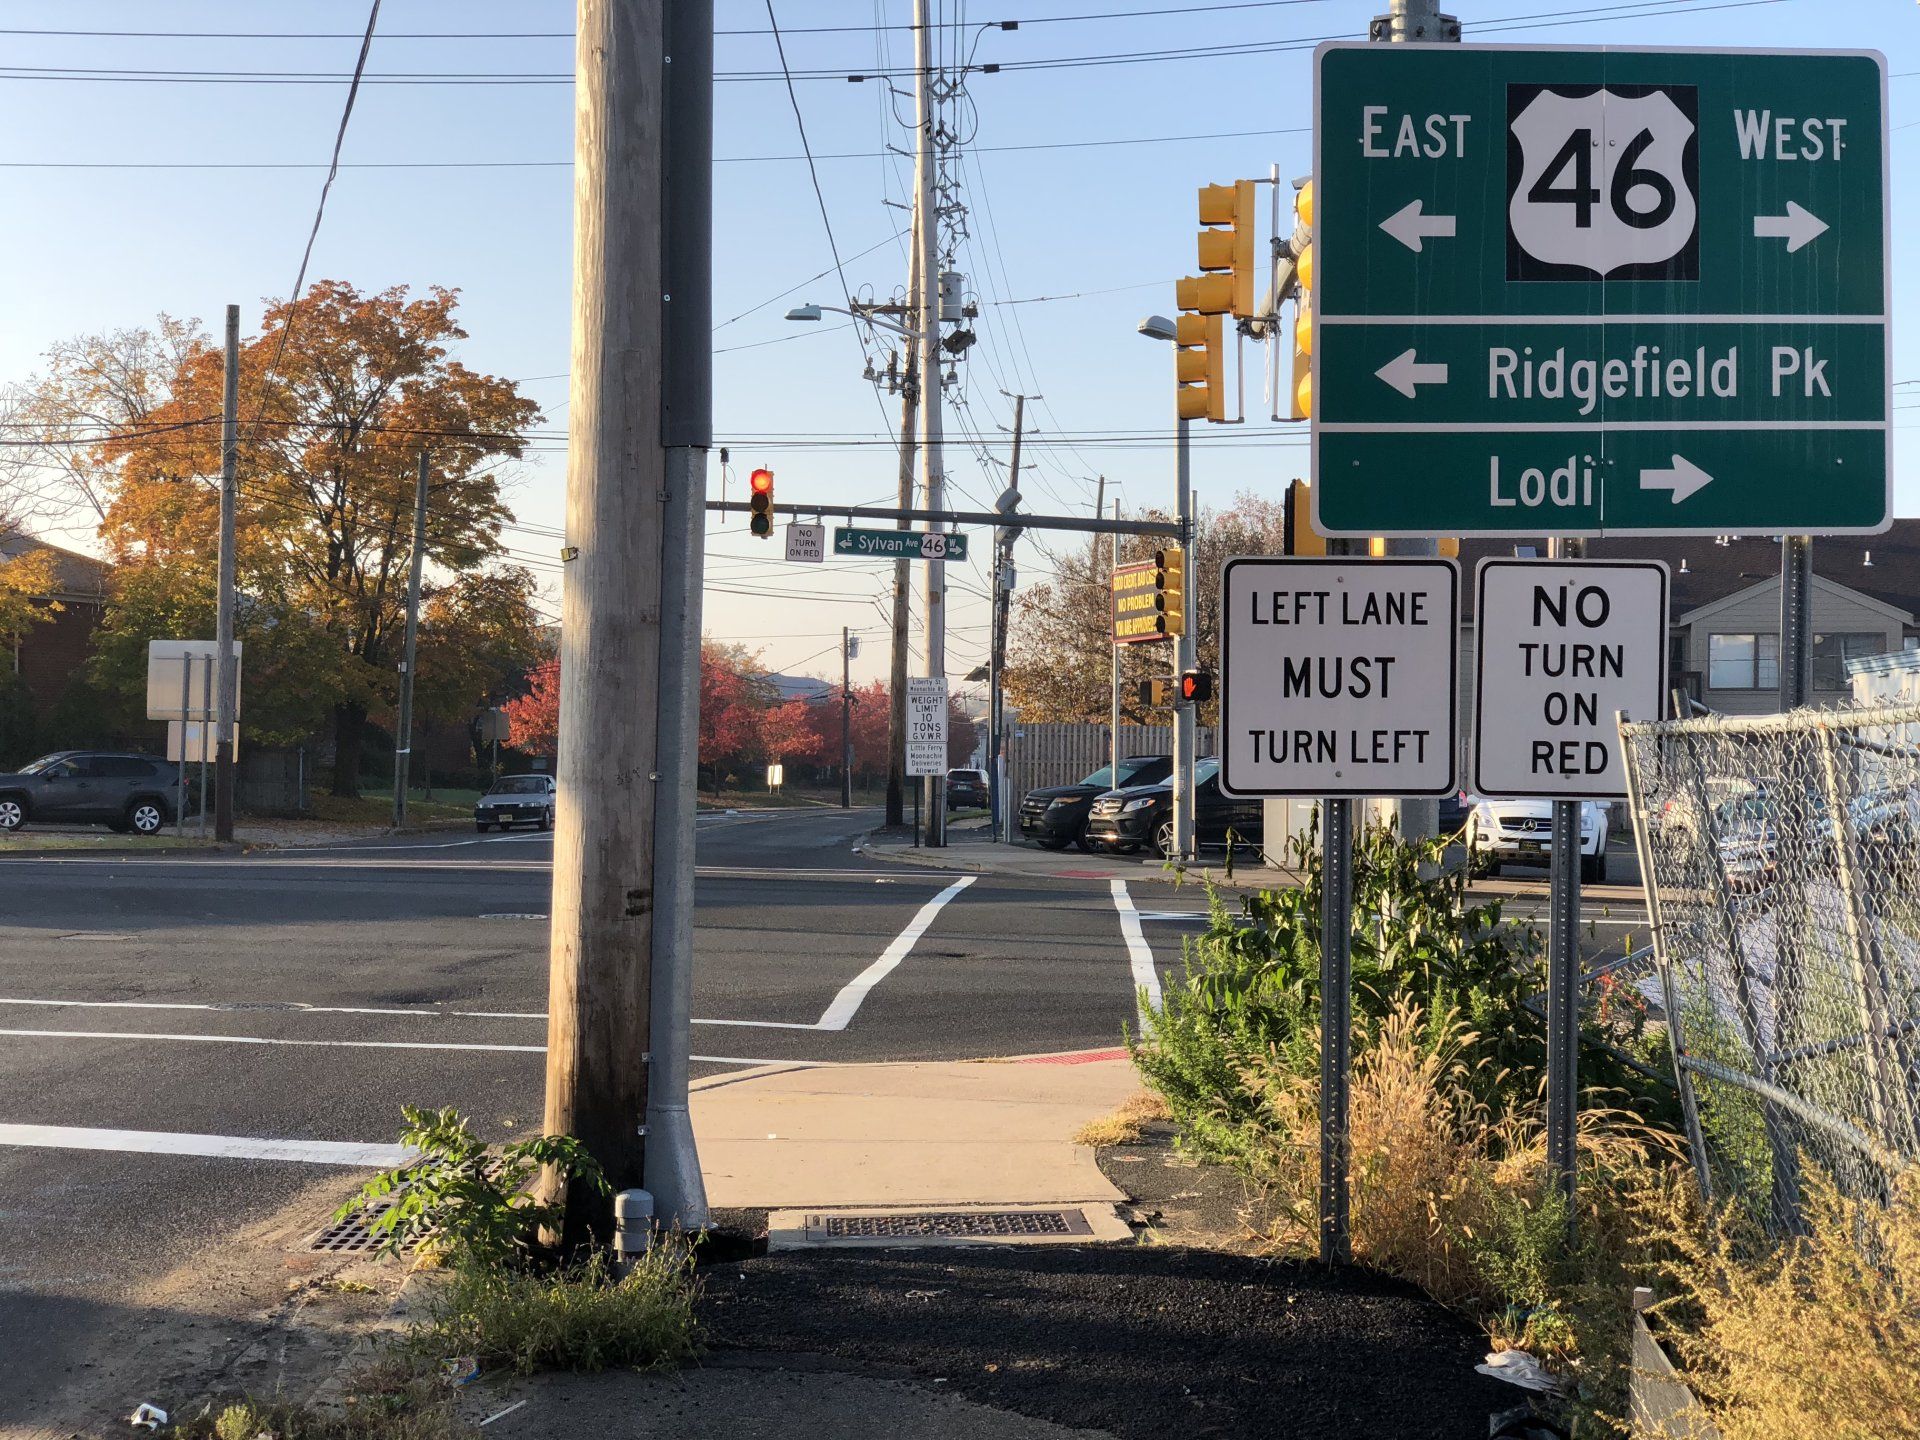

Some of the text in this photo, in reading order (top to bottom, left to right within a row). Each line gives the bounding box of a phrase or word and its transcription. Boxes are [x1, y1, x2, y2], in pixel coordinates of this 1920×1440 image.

[1362, 105, 1471, 158] EAST
[1733, 109, 1847, 161] WEST
[1527, 127, 1676, 229] 46
[1489, 345, 1832, 416] Ridgefield Pk
[1490, 454, 1592, 507] Lodi
[795, 539, 816, 547] TURN
[803, 549, 820, 557] RED
[858, 535, 919, 553] Sylvan Ave
[923, 538, 944, 553] 46
[1118, 598, 1126, 612] NO
[1252, 591, 1428, 625] LEFT LANE
[1533, 585, 1611, 628] NO
[1283, 656, 1395, 699] MUST
[1519, 643, 1624, 678] TURN
[911, 696, 943, 704] WEIGHT
[1544, 692, 1598, 726] ON
[913, 723, 941, 731] TONS
[922, 713, 933, 722] 10
[1248, 730, 1430, 764] TURN LEFT
[1531, 740, 1609, 775] RED
